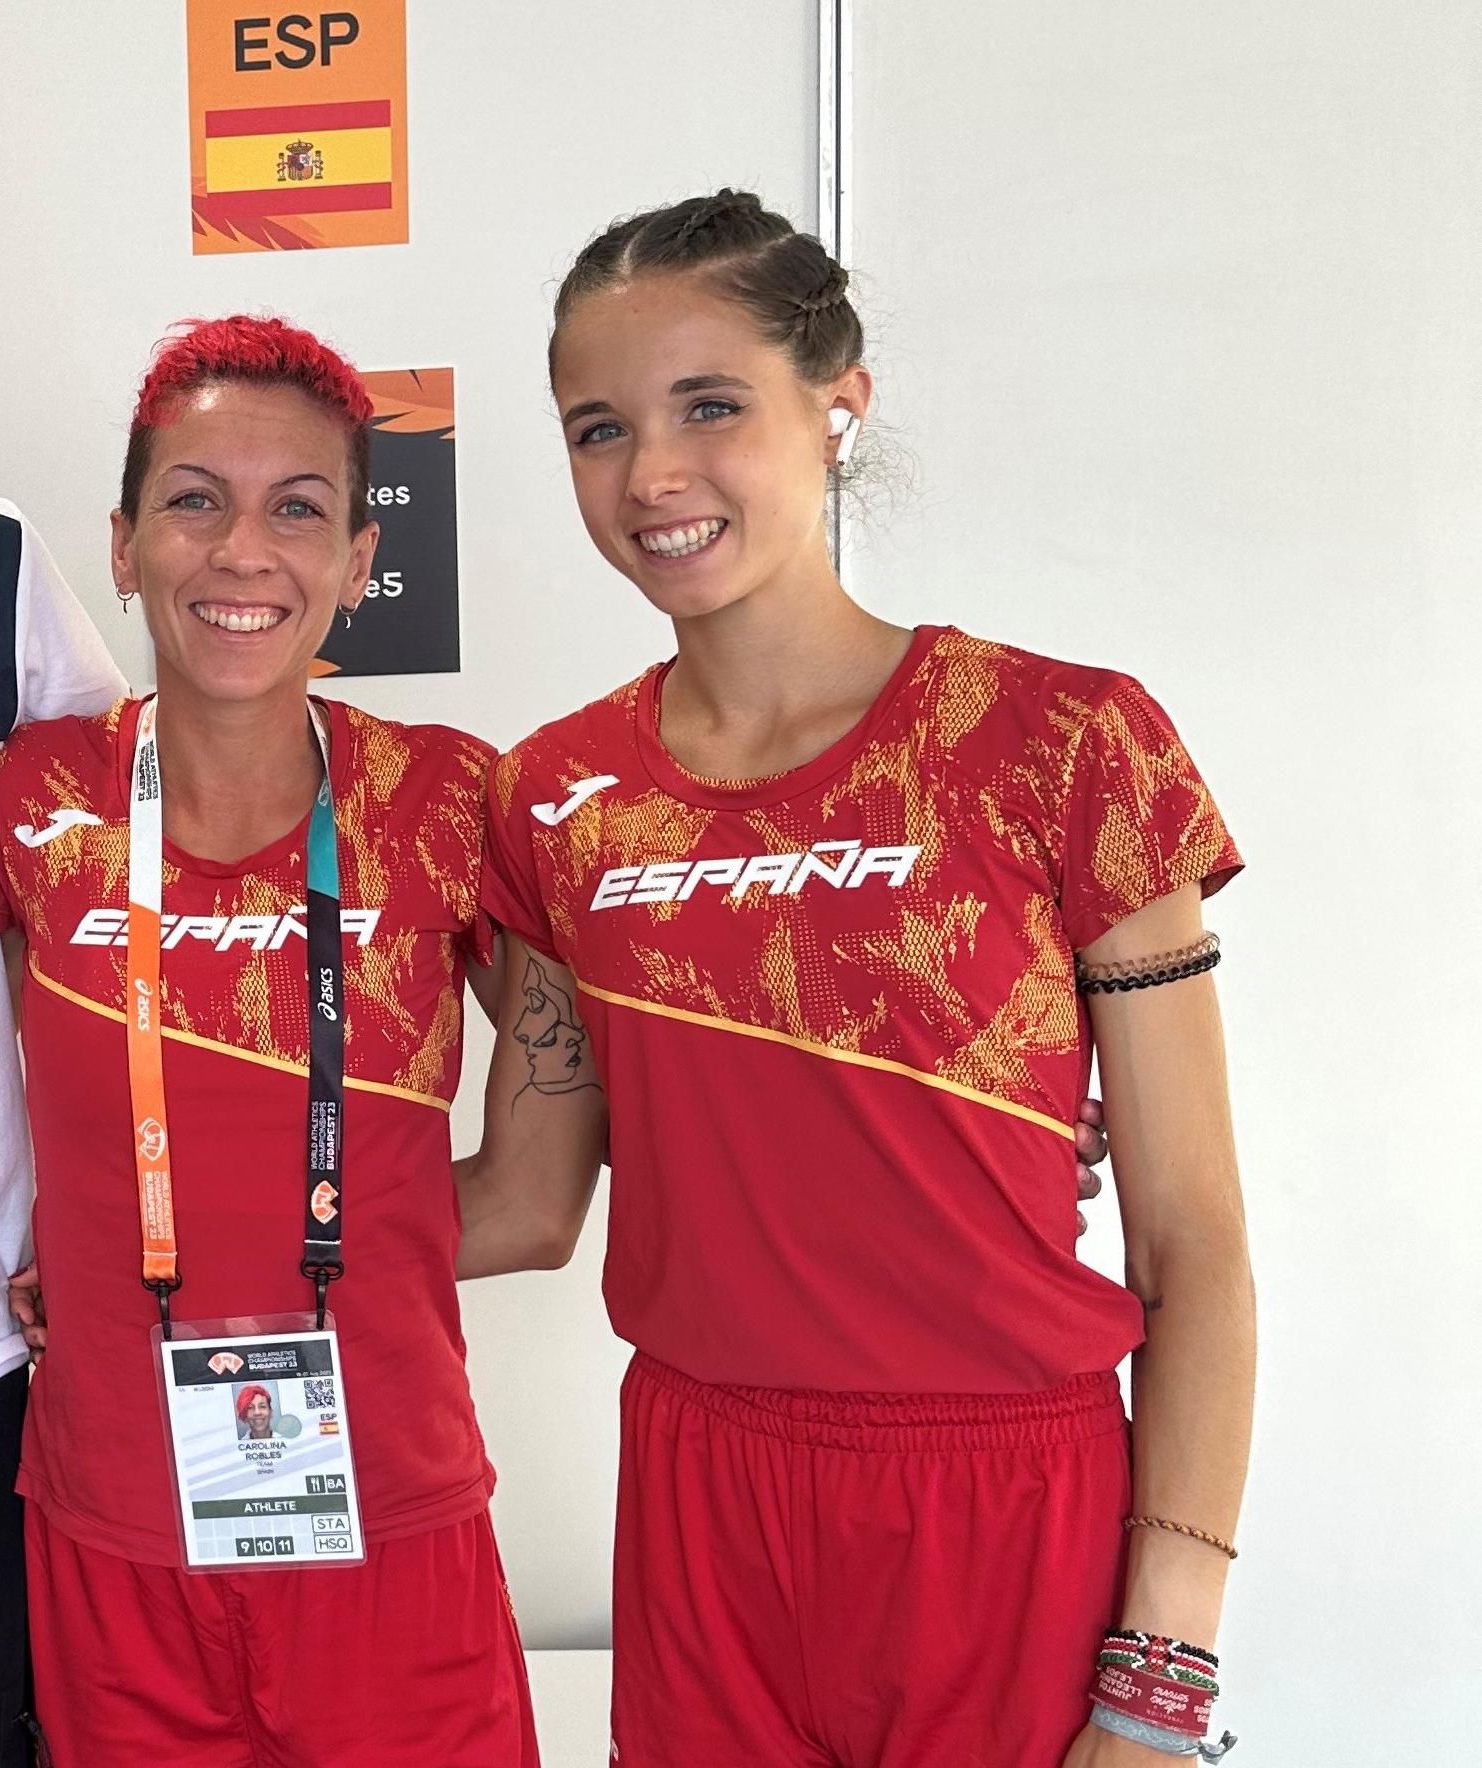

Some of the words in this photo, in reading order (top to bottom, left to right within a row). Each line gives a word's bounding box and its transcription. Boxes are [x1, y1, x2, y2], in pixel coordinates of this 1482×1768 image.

[234, 12, 360, 72] ESP
[366, 483, 411, 506] tes
[364, 571, 404, 598] e5
[589, 838, 925, 912] ESPAÑA
[321, 967, 333, 1003] asics
[138, 996, 150, 1032] asics
[327, 1101, 336, 1114] 23
[311, 1101, 319, 1142] ATHLETICS
[318, 1101, 327, 1171] CHAMPIONSHIPS
[326, 1115, 335, 1171] BUDAPEST
[310, 1142, 318, 1170] WORLD
[320, 1413, 337, 1421] ESP
[237, 1440, 287, 1452] CAROLINA
[245, 1451, 282, 1461] ROBLES
[327, 1478, 345, 1489] BA
[244, 1501, 296, 1513] ATHLETE
[317, 1518, 346, 1529] STA
[240, 1541, 250, 1553] 9
[257, 1540, 273, 1552] 10
[278, 1539, 291, 1551] 11
[319, 1538, 348, 1551] HSQ
